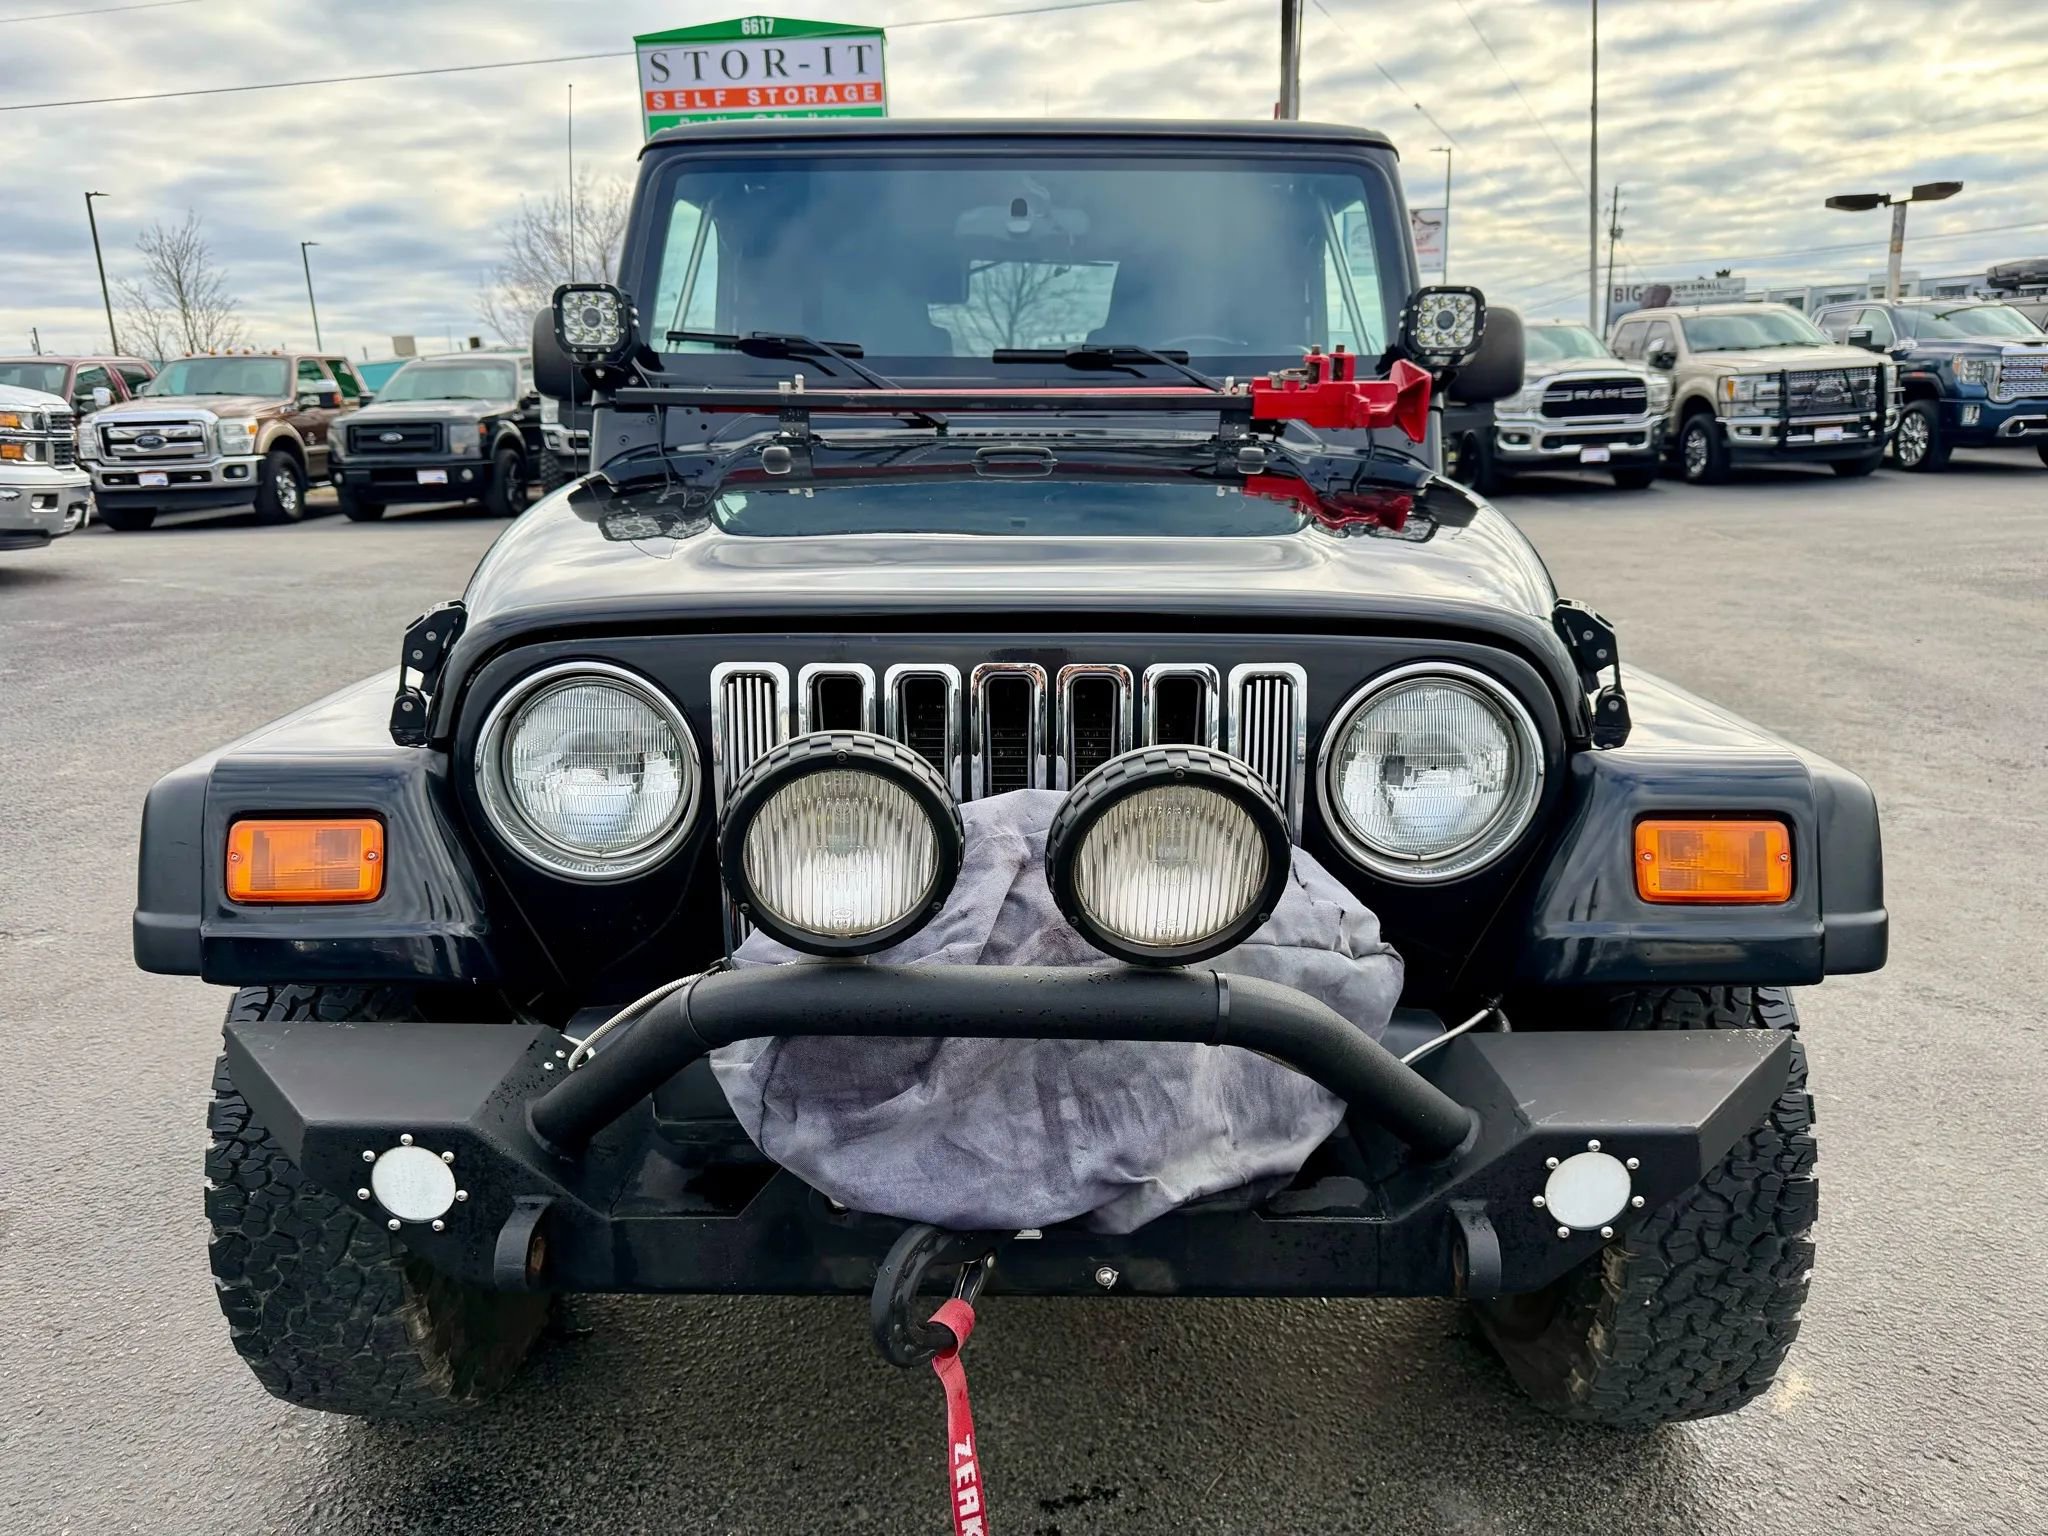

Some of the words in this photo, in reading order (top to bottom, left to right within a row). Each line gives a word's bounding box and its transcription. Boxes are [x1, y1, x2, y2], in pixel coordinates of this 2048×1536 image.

[741, 18, 775, 35] 6617
[650, 44, 873, 83] STOR-IT
[654, 90, 727, 109] SELF
[747, 84, 877, 106] STORAGE
[1614, 286, 1642, 302] BIG
[1574, 388, 1620, 400] RAM
